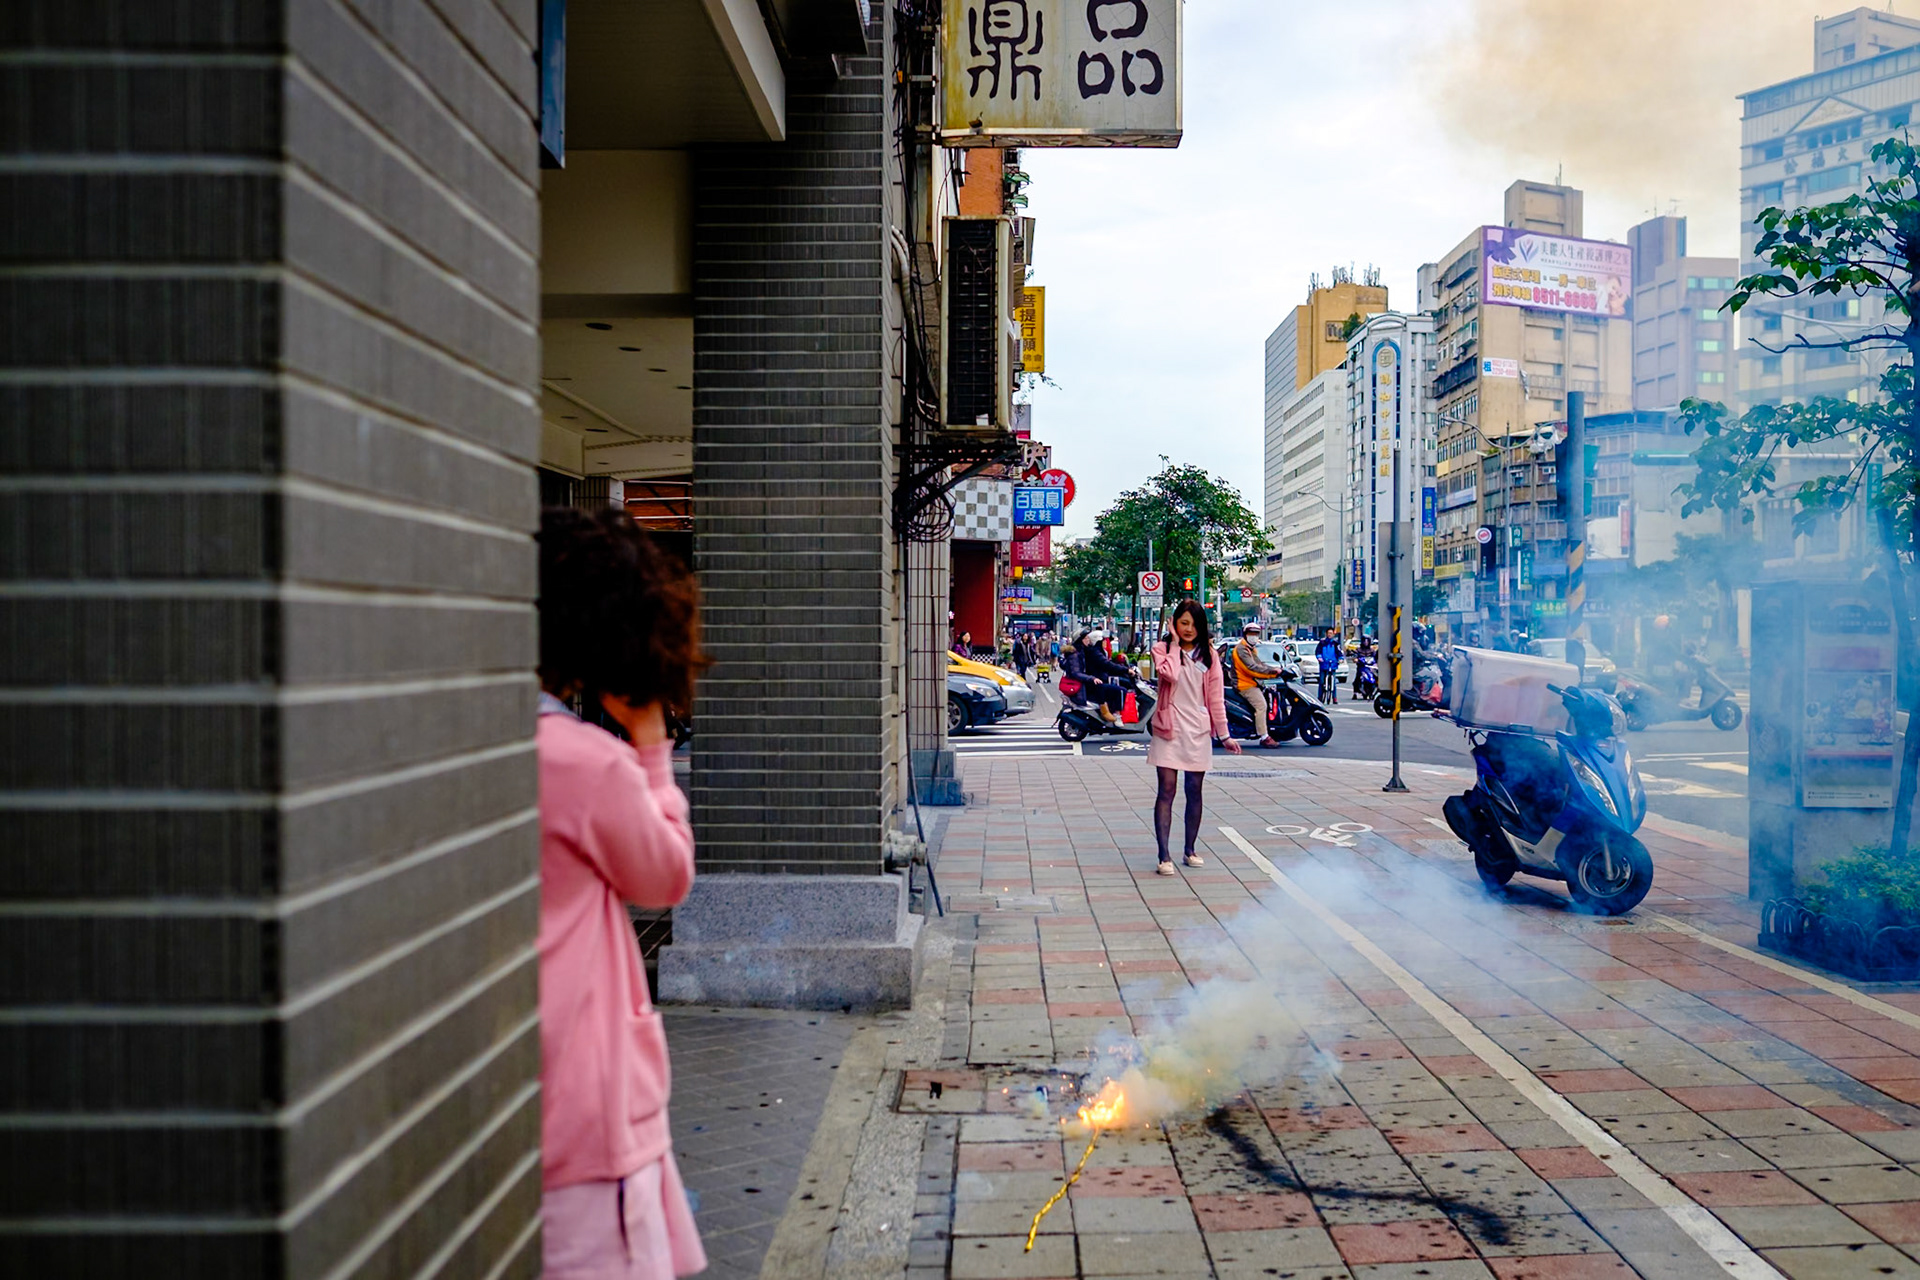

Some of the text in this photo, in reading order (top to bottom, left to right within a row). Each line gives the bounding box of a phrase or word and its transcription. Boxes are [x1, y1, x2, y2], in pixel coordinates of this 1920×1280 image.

[967, 0, 1043, 100] 鼎
[1077, 0, 1164, 99] 品
[1016, 491, 1060, 509] 百靈鳥
[1024, 509, 1052, 522] 皮鞋
